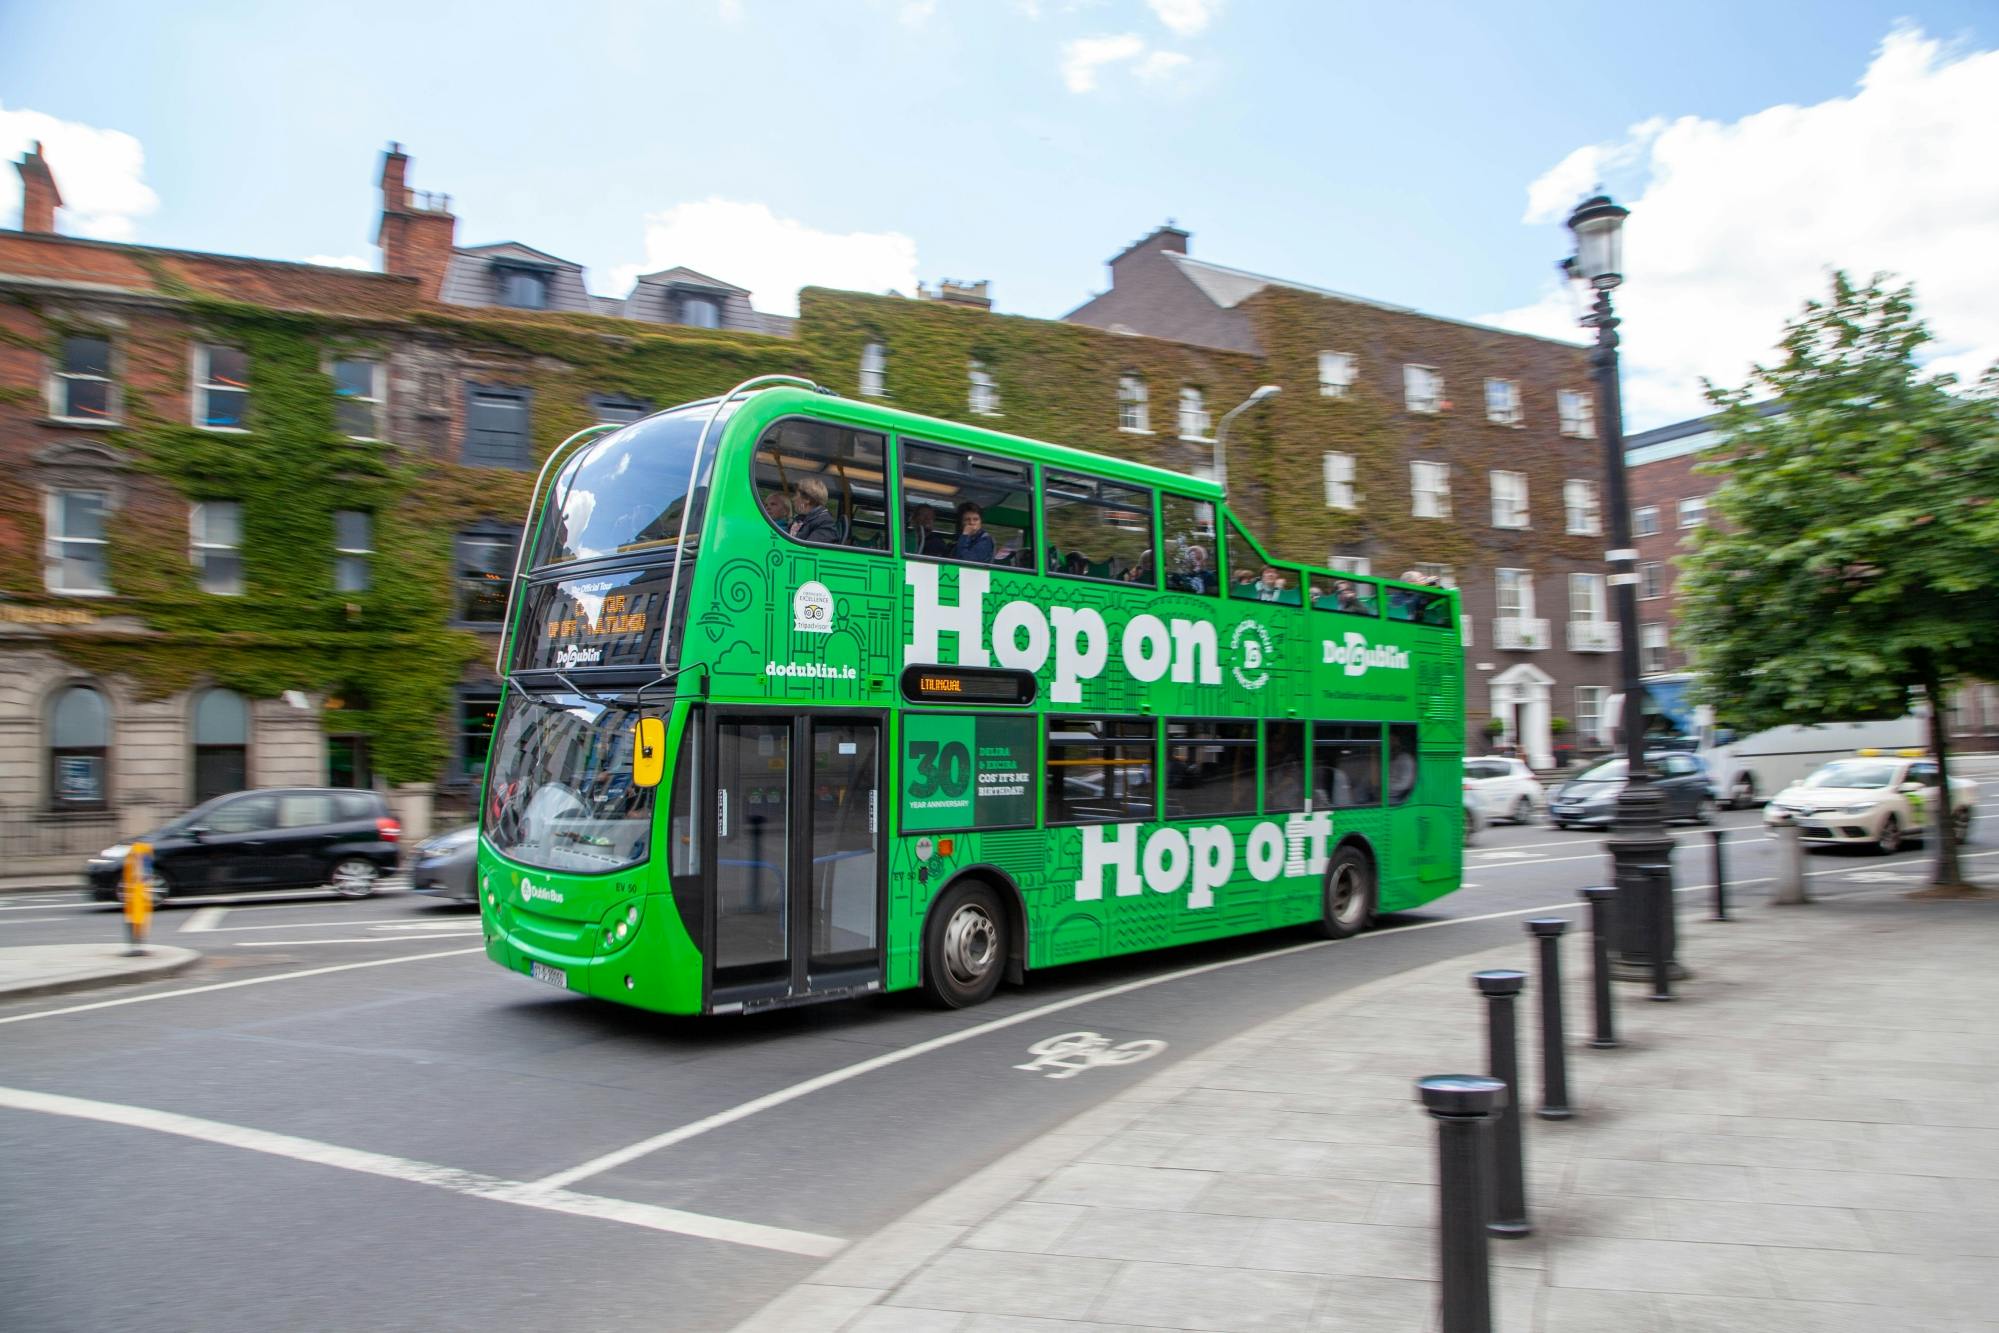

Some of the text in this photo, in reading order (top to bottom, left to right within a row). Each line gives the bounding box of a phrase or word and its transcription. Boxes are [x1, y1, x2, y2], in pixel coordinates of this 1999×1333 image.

[904, 560, 1222, 702] Hop on
[765, 661, 857, 680] dodublin.ie
[908, 741, 971, 799] 30
[910, 799, 969, 809] YEAR ANNIVERSARY
[1074, 822, 1234, 909] Hop
[615, 882, 637, 893] EV 50
